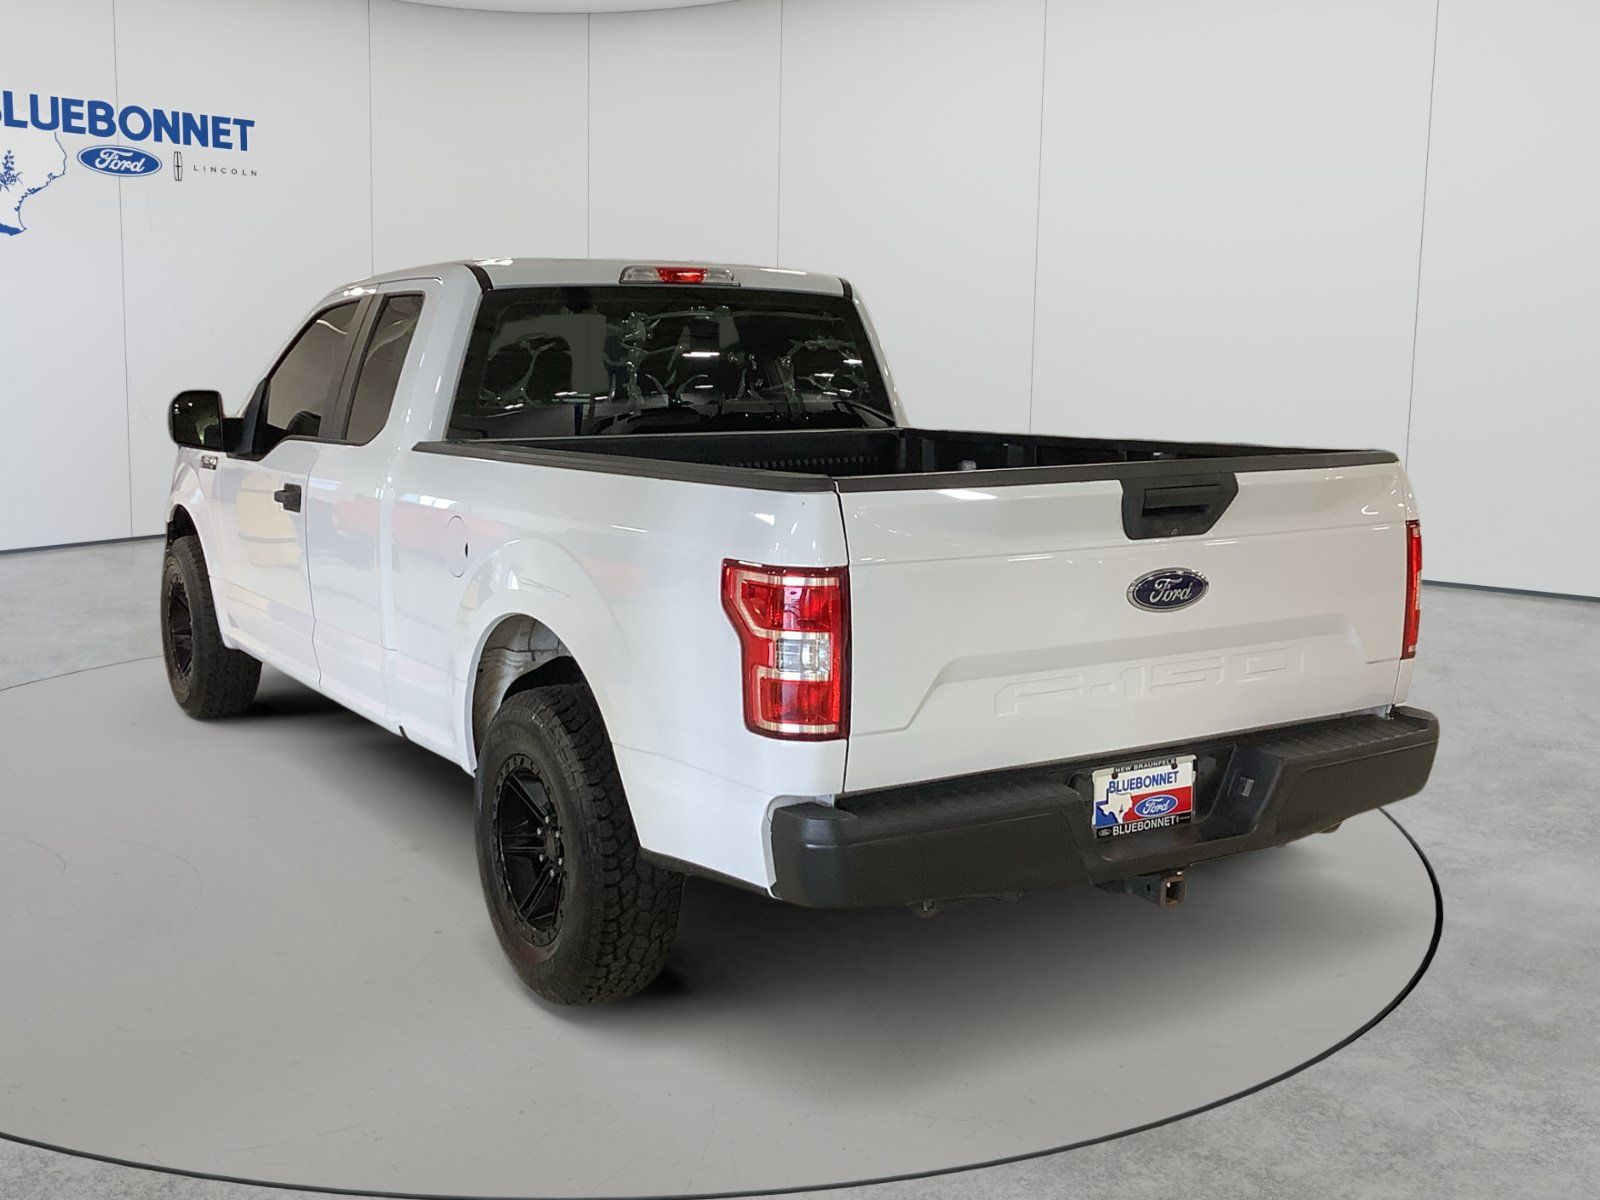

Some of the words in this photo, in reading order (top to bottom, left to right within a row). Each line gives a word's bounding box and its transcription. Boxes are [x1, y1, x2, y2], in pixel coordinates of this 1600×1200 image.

[0, 90, 256, 152] LUEBONNET
[93, 147, 147, 174] Ford
[193, 164, 258, 177] LINCOLN
[1149, 577, 1193, 603] Ford
[994, 645, 1304, 717] F-150
[1114, 765, 1132, 773] NEW
[1108, 770, 1180, 793] BLUEBONNET
[1141, 798, 1171, 815] Ford
[1112, 815, 1176, 836] BLUEBONNET
